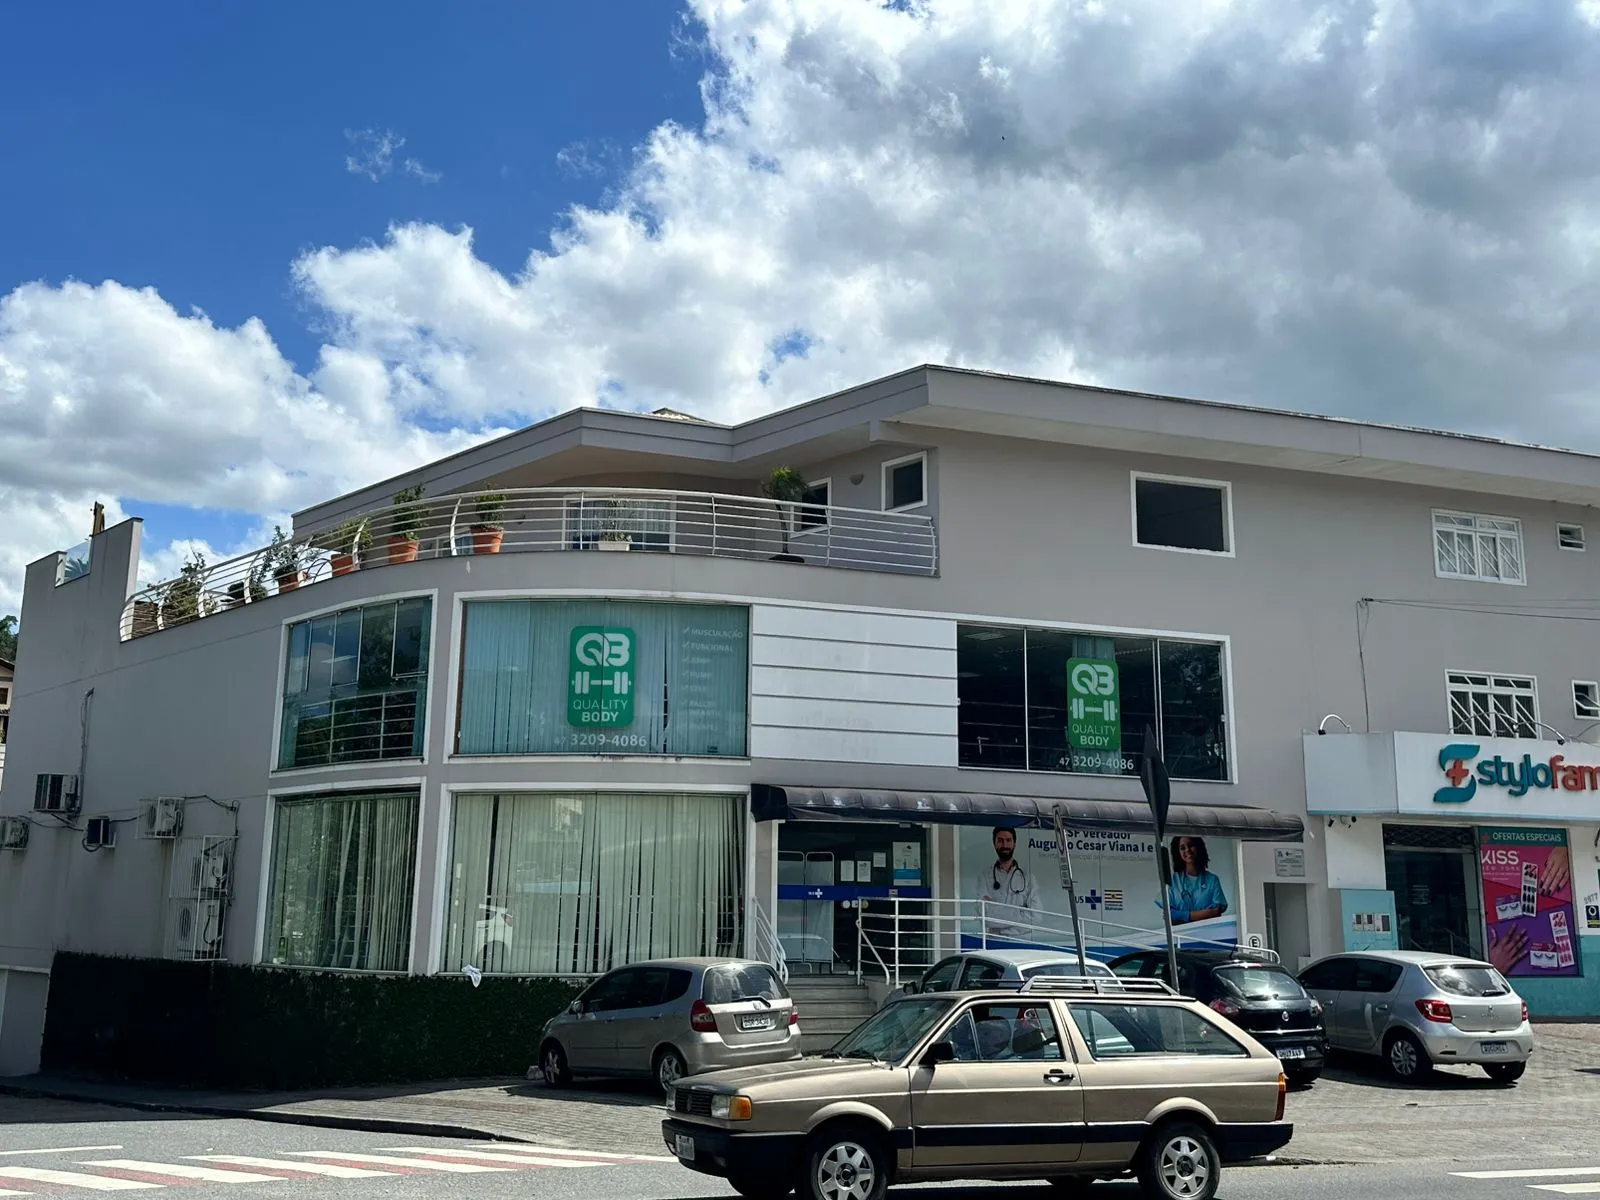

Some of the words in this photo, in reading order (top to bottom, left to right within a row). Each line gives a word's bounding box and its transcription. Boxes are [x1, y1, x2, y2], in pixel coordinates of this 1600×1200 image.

[576, 633, 630, 667] QB
[1072, 664, 1115, 695] QB
[573, 699, 628, 711] QUALITY
[582, 711, 619, 722] BODY
[1072, 724, 1117, 735] QUALITY
[571, 733, 647, 747] 3209-4086
[1080, 735, 1110, 746] BODY
[1059, 757, 1070, 766] 47
[1073, 755, 1135, 770] 3209-4086
[1493, 832, 1525, 841] OFERTAS
[1526, 833, 1562, 842] ESPECIAIS
[1028, 838, 1074, 852] Auguo
[1076, 840, 1105, 851] Cesar
[1108, 841, 1138, 852] Viana
[1480, 850, 1519, 865] KISS
[1074, 896, 1084, 904] US
[1251, 938, 1258, 947] E
